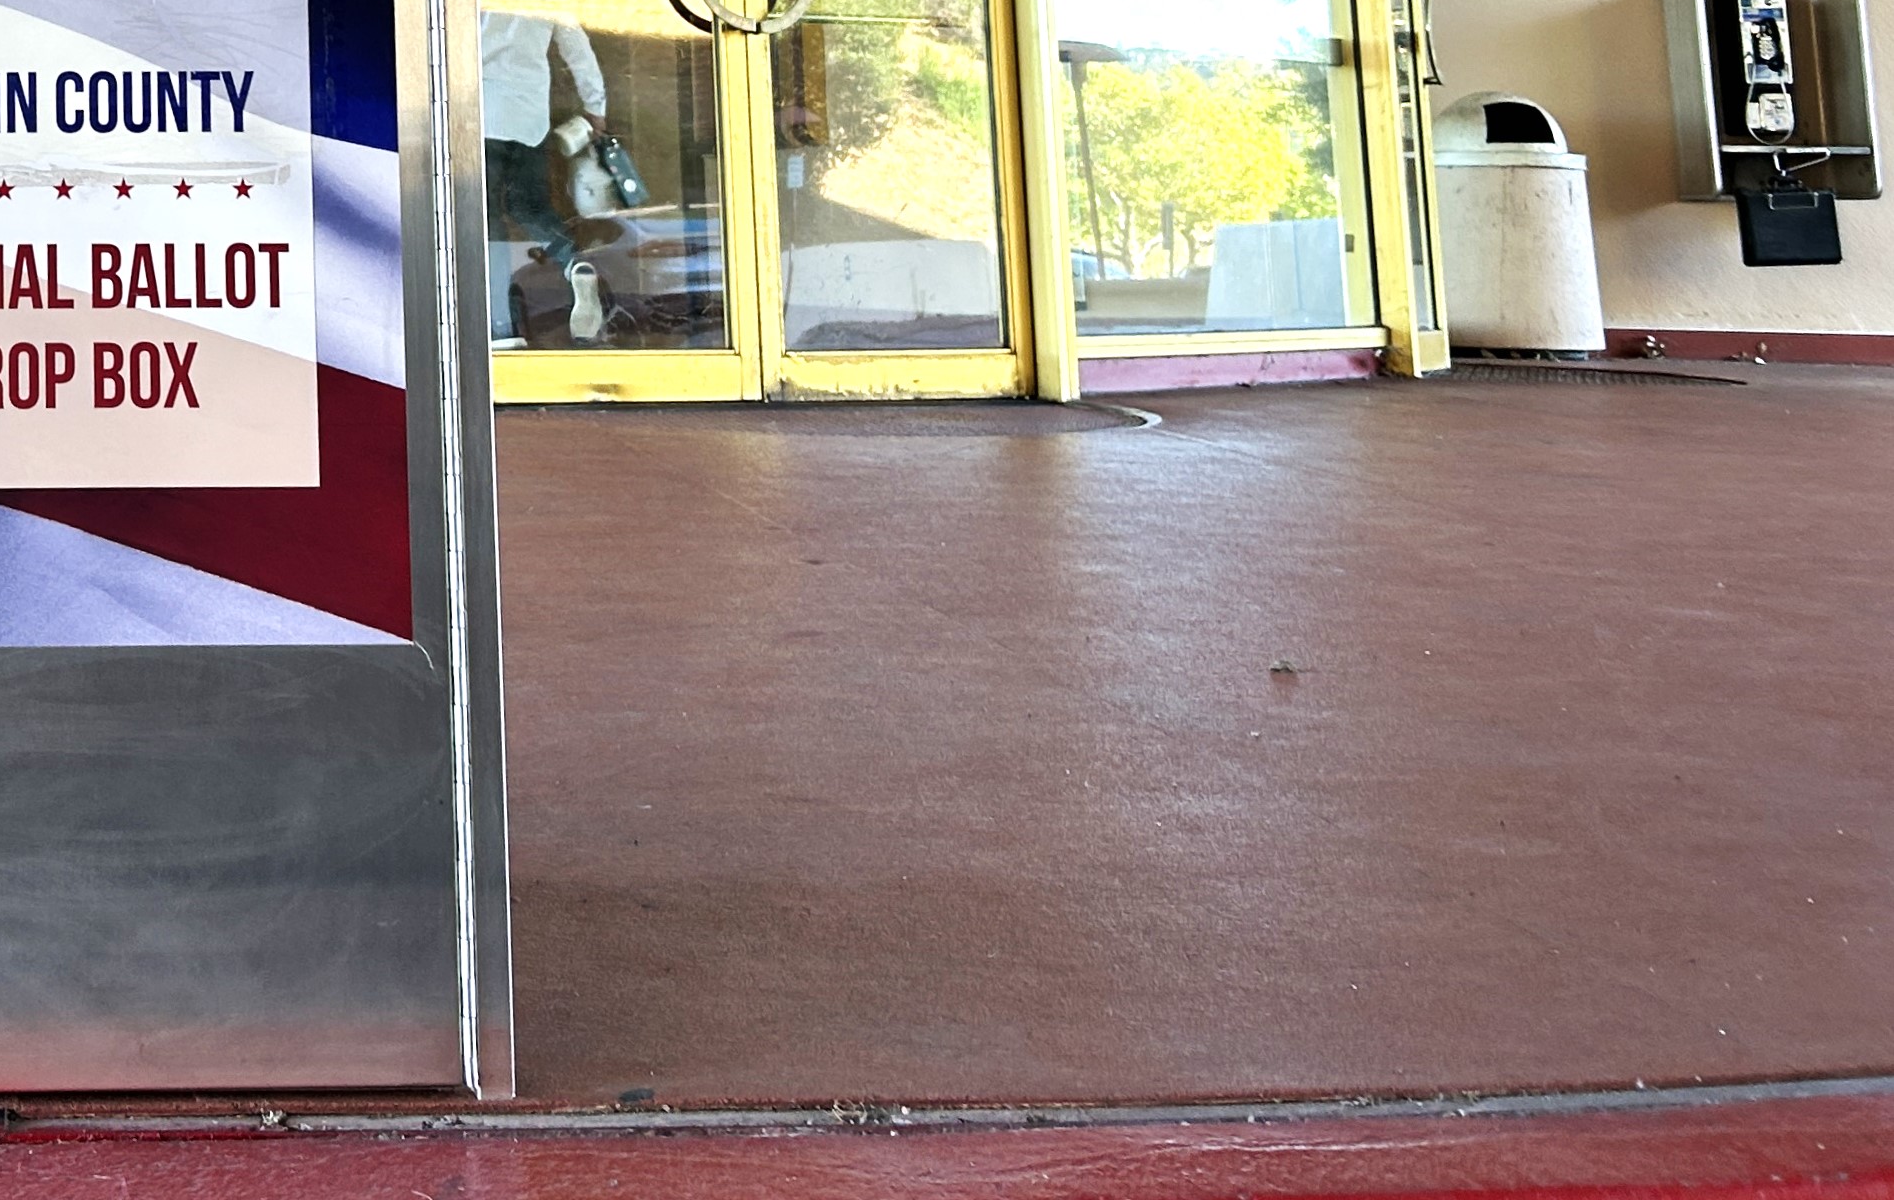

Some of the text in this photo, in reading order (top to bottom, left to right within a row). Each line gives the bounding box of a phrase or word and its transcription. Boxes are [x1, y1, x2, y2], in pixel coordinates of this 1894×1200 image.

[55, 70, 255, 134] COUNTY
[91, 242, 290, 309] BALLOT
[93, 341, 200, 409] BOX
